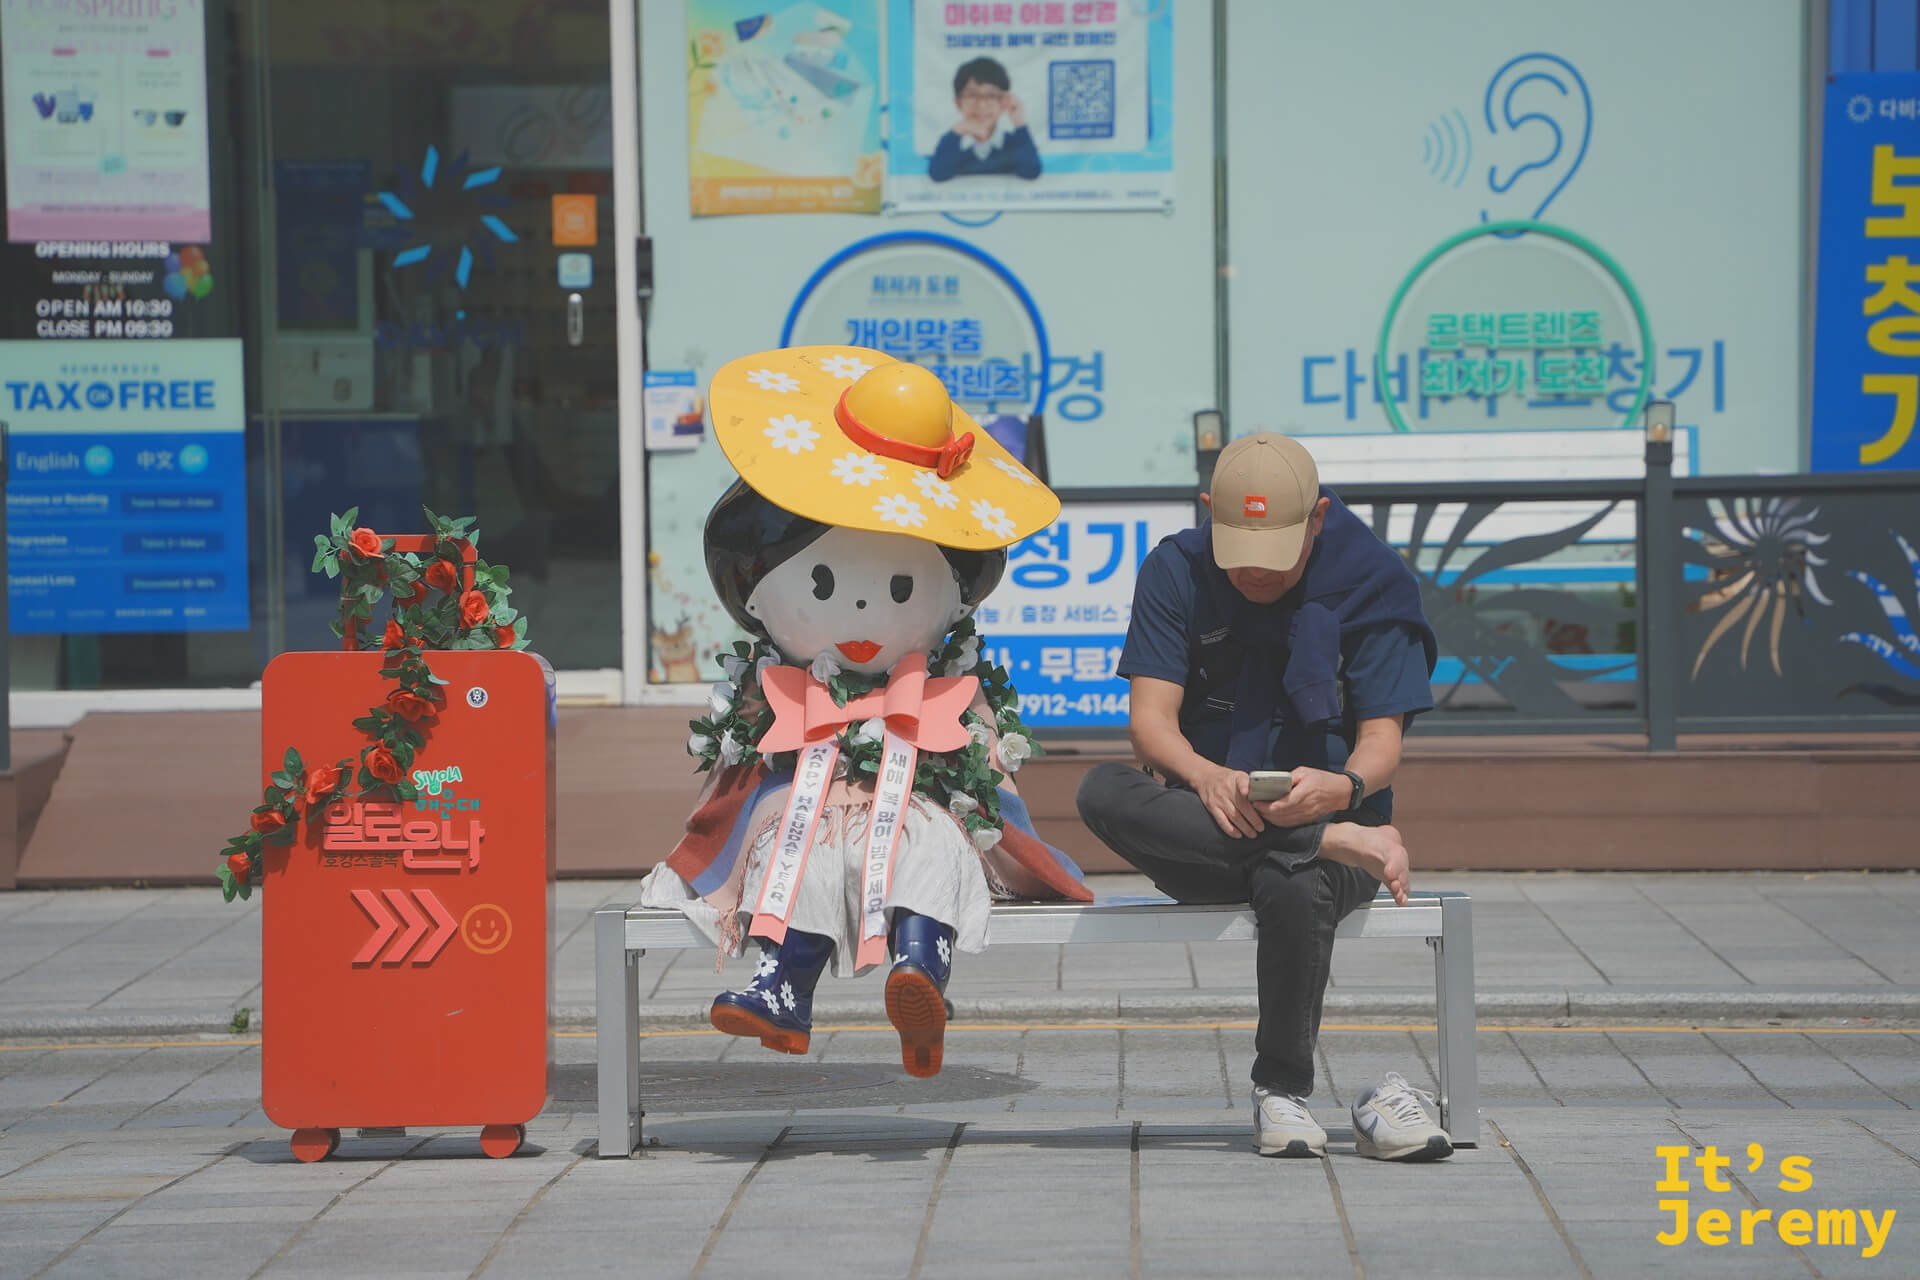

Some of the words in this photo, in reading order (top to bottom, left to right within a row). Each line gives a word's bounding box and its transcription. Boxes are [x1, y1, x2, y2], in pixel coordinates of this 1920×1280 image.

[35, 242, 109, 258] OPENING
[112, 242, 170, 258] HOURS
[36, 301, 89, 316] OPEN
[94, 301, 121, 316] AM
[125, 300, 172, 316] 10:30
[36, 320, 89, 337] CLOSE
[95, 320, 122, 337] PM
[125, 320, 173, 337] 09:30
[847, 319, 981, 352] 개인맞춤
[1428, 312, 1602, 345] 콘택트렌즈
[1422, 359, 1527, 396] 최저가
[1537, 357, 1611, 394] 도전
[5, 381, 82, 411] TAX
[119, 380, 215, 410] FREE
[16, 452, 80, 472] English
[136, 450, 173, 470] 中文
[1064, 604, 1119, 623] 서비스
